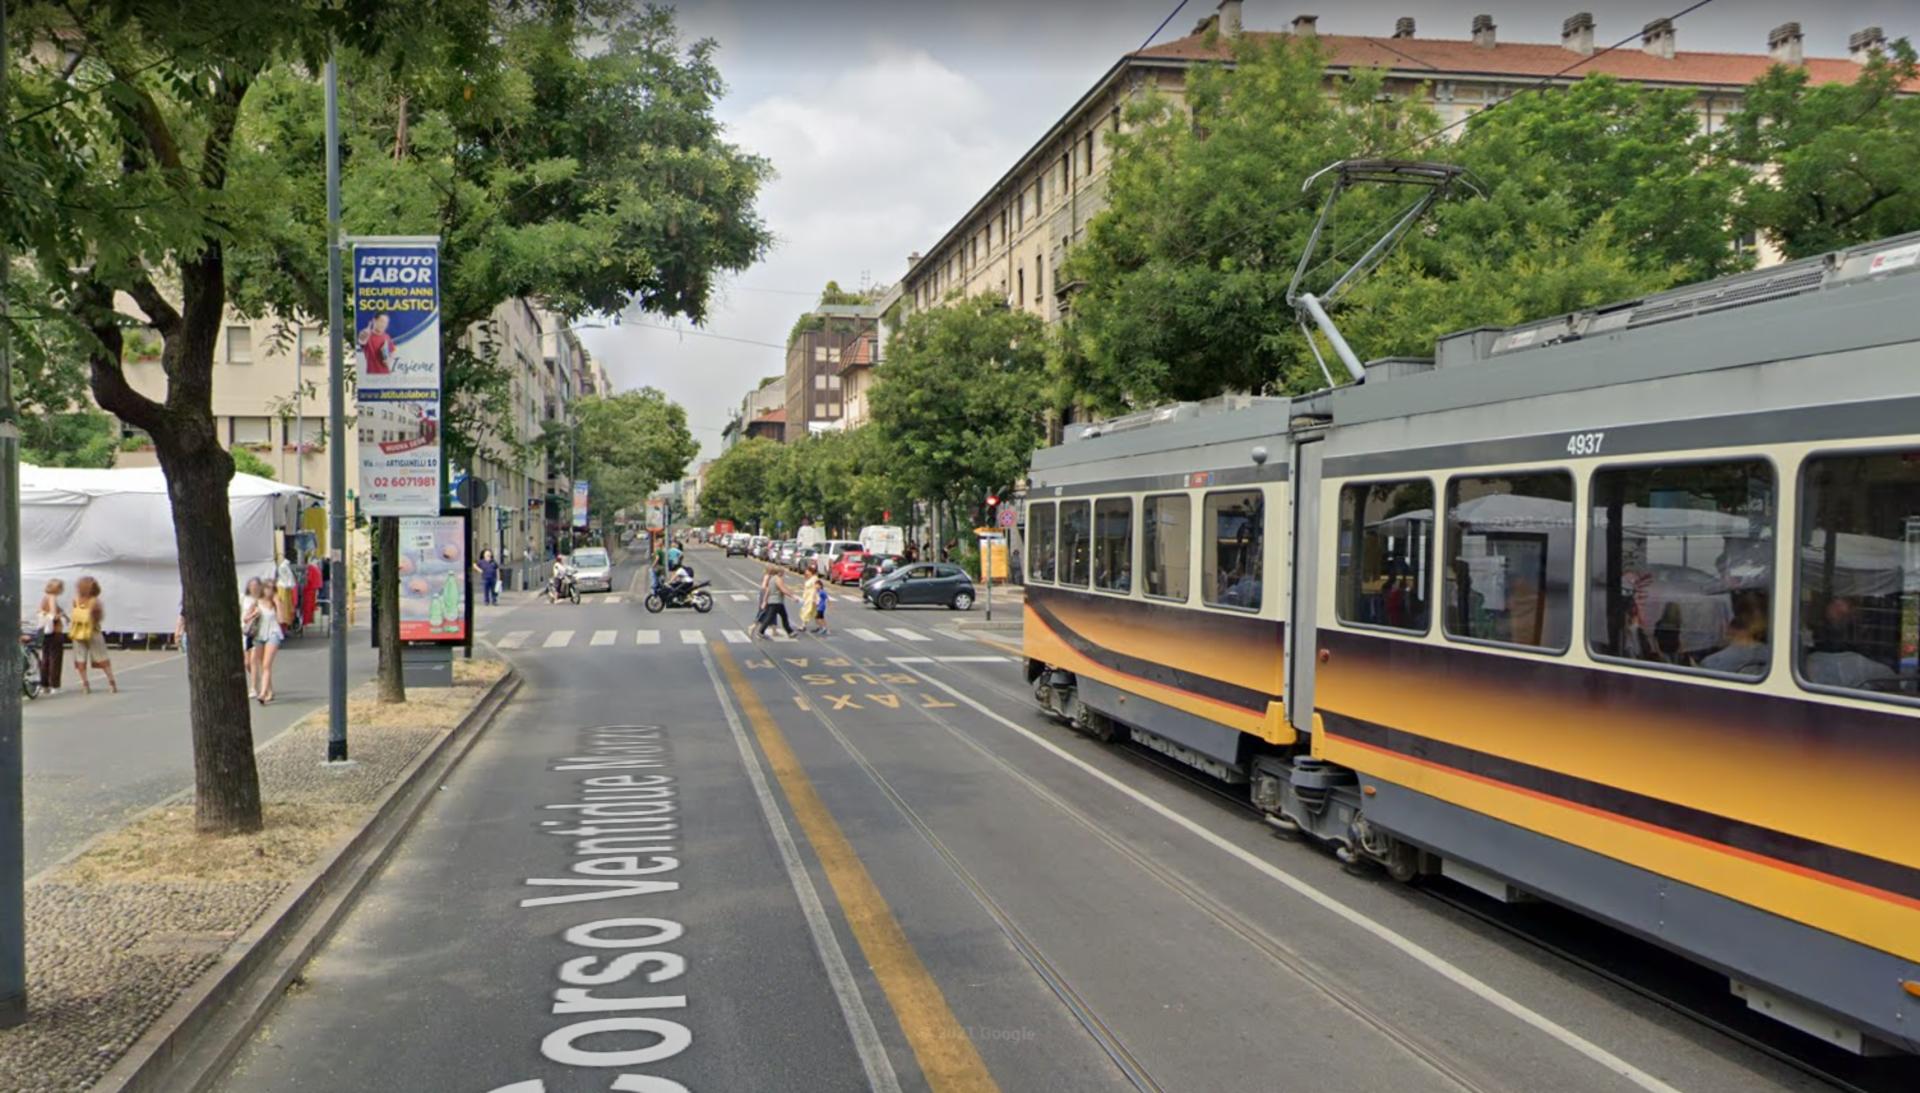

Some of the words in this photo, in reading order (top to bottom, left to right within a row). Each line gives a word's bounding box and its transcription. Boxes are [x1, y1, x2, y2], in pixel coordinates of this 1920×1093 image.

[361, 256, 433, 265] ISTITUTO
[359, 268, 431, 283] LABOR
[359, 288, 408, 296] RECUPERO
[410, 288, 433, 296] ANNI
[359, 299, 434, 311] SCOLASTICI
[391, 357, 434, 373] Insieme
[1567, 433, 1604, 454] 4937
[428, 459, 437, 467] 10
[374, 477, 389, 487] 02
[391, 477, 436, 487] 6071981
[746, 657, 889, 669] TRAM
[801, 673, 918, 685] BUS
[793, 693, 957, 711] TAXI
